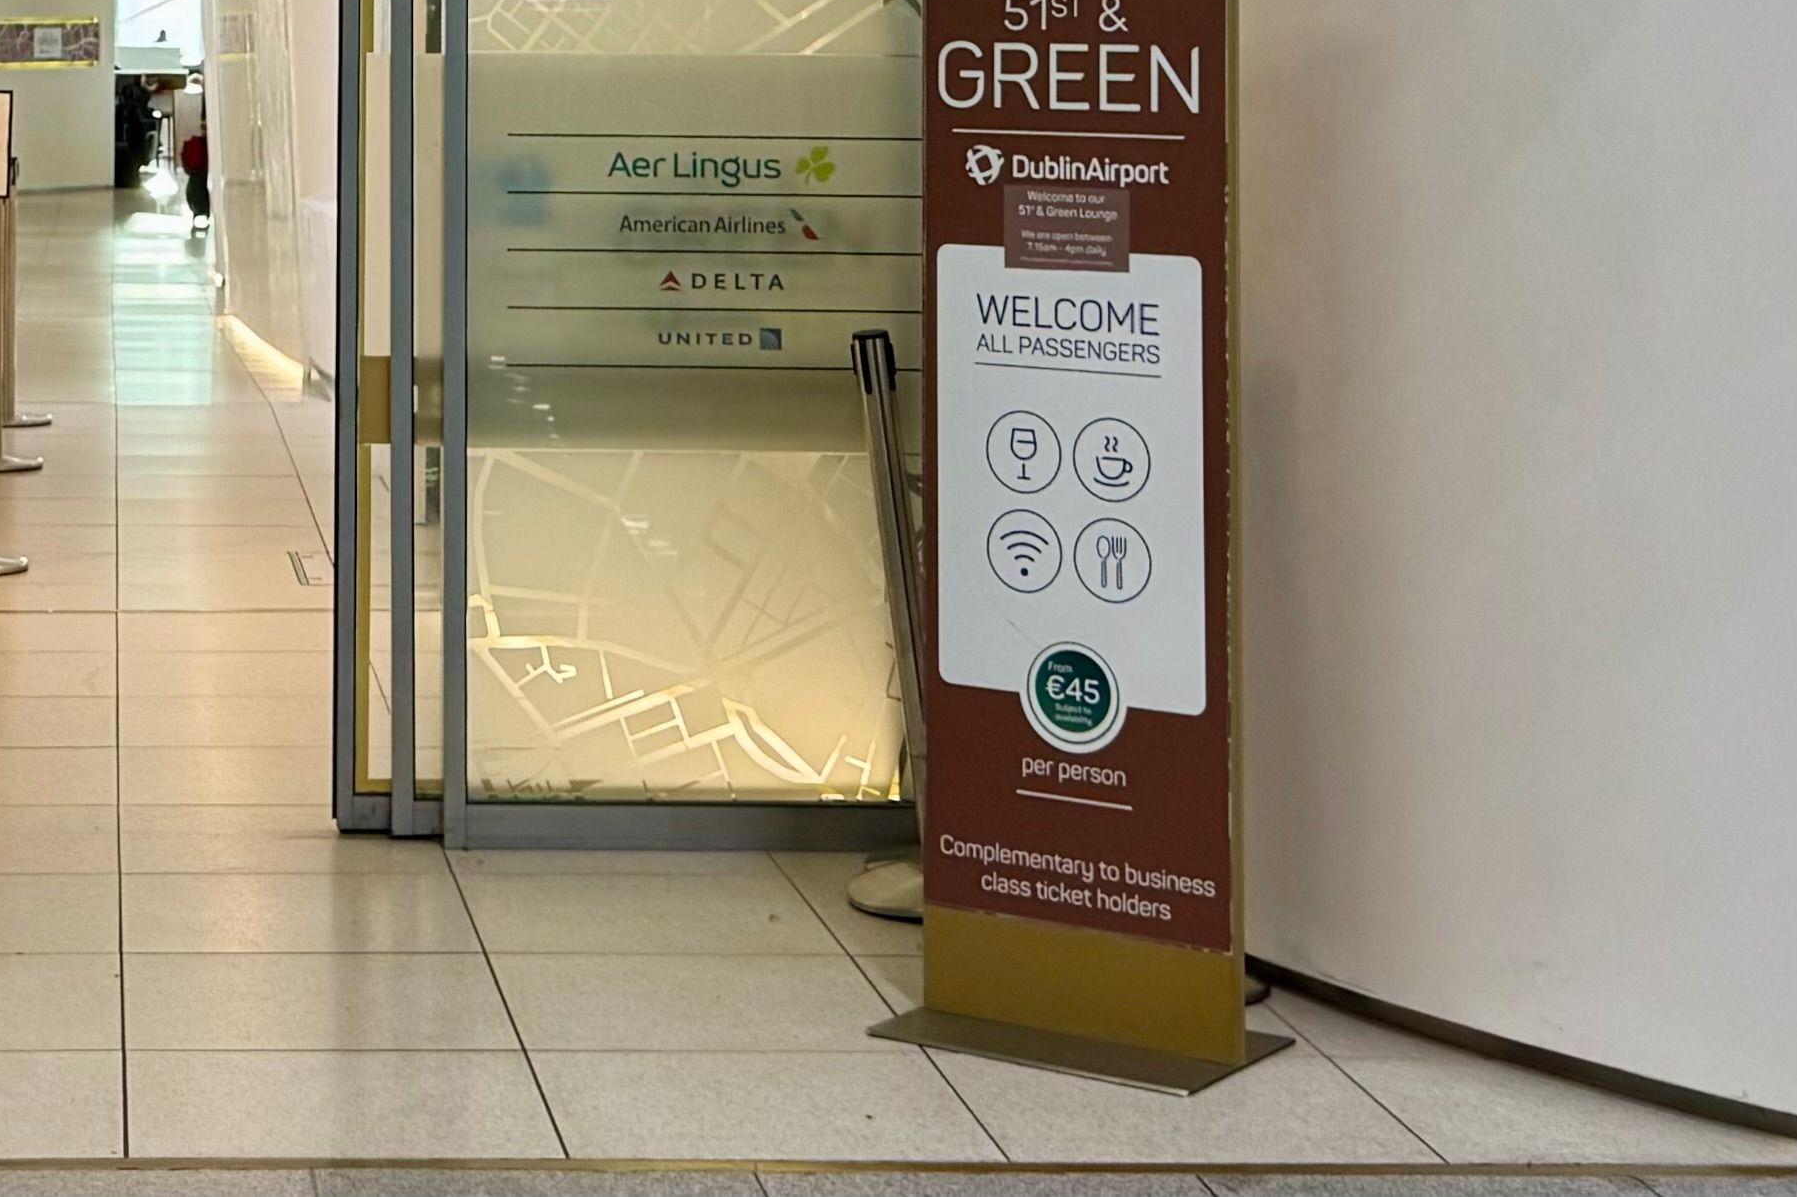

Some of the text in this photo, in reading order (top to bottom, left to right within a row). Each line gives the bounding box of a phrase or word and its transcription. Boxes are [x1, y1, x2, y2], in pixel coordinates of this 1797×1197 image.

[937, 40, 1200, 114] GREEN
[608, 151, 781, 188] Aer Lingus
[1012, 154, 1170, 188] DublinAirport
[1027, 190, 1106, 205] Welcome to our
[619, 215, 786, 234] American Airlines
[1036, 205, 1045, 217] &
[1046, 205, 1078, 218] Green
[1079, 206, 1119, 223] Lounge
[691, 272, 785, 291] DELTA
[976, 292, 1160, 337] WELCOME
[658, 332, 752, 345] UNITED
[976, 333, 1161, 364] ALL PASSENGERS
[1047, 660, 1074, 673] From
[1045, 674, 1101, 705] €45
[1022, 756, 1126, 787] per person
[940, 834, 1216, 898] Complementary to business
[981, 872, 1173, 920] class ticket holders
